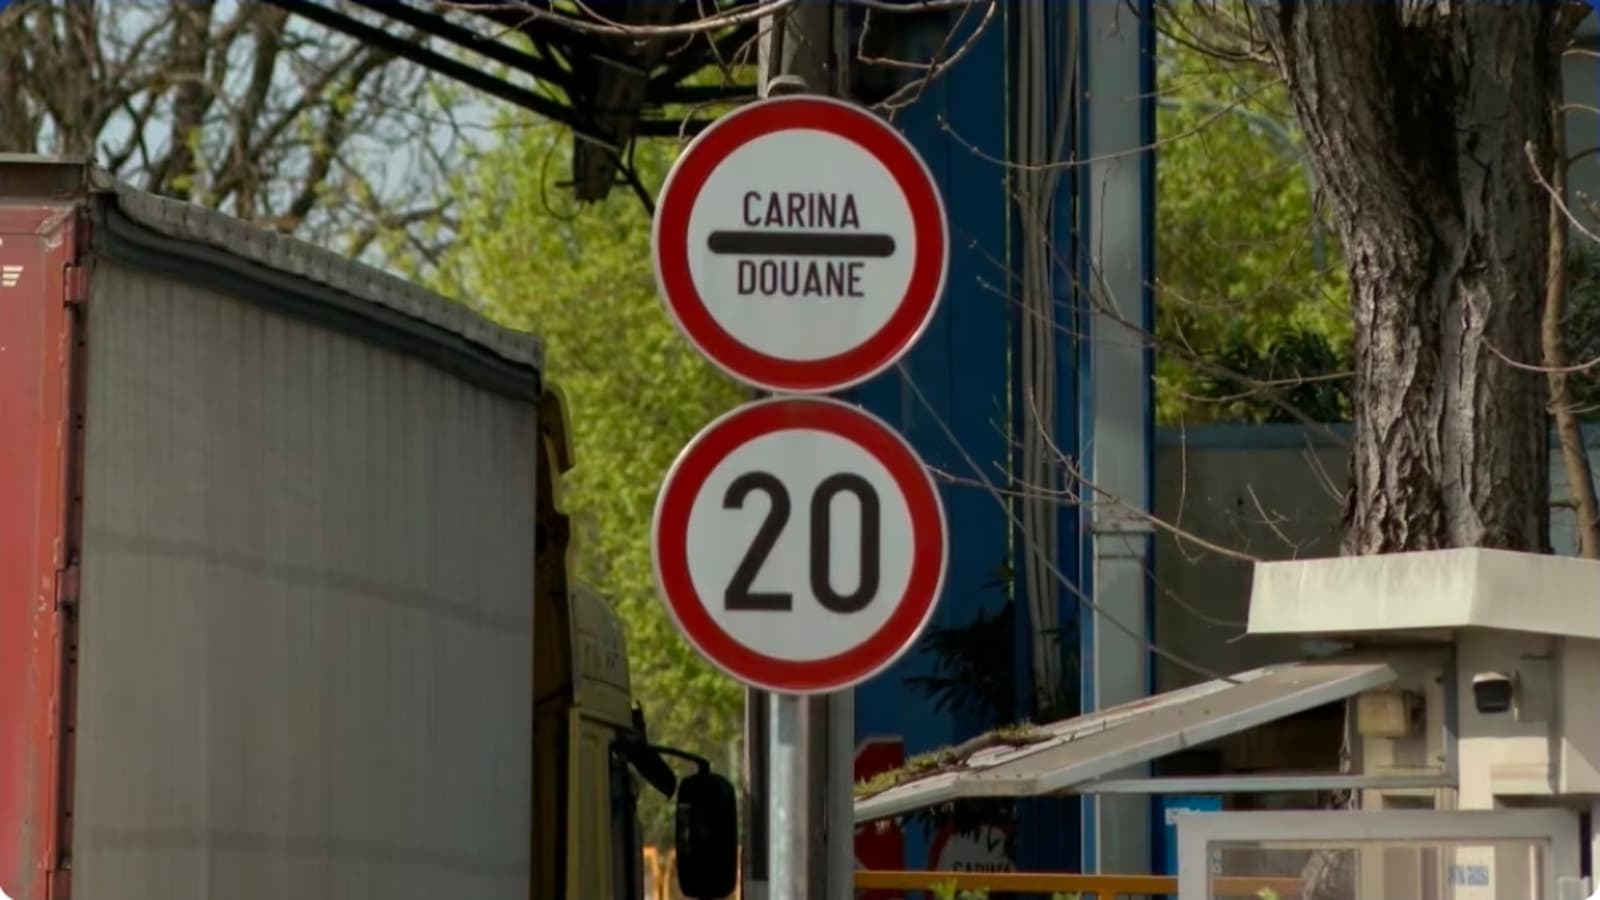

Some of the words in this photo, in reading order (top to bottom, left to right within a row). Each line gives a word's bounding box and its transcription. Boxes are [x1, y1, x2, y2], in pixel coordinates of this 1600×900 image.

[743, 191, 860, 228] CARINA
[737, 260, 865, 297] DOUANE
[722, 471, 880, 615] 20
